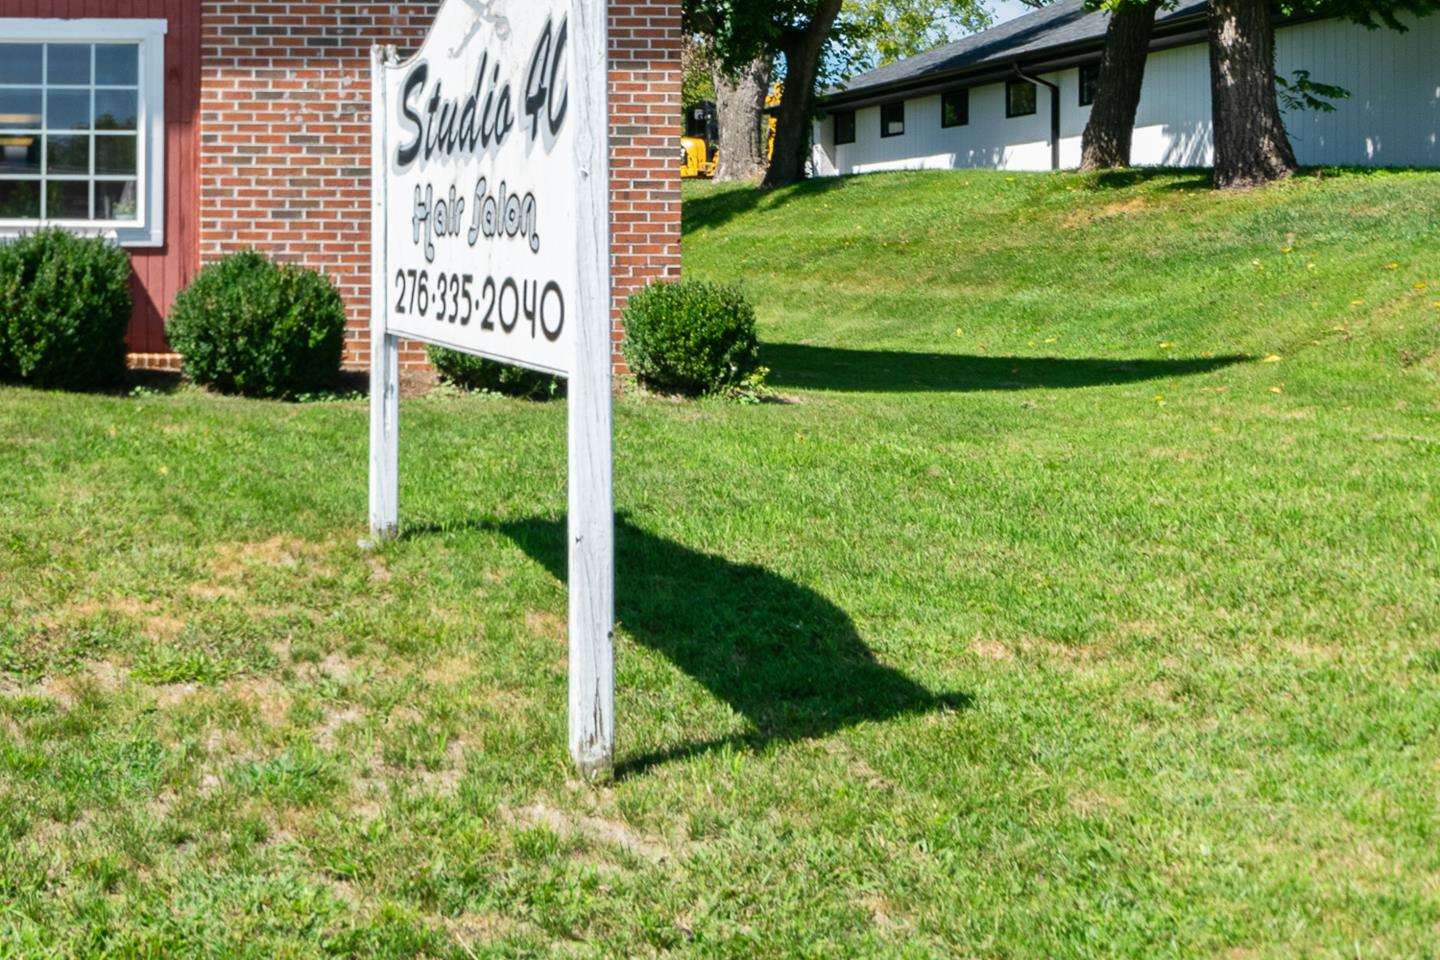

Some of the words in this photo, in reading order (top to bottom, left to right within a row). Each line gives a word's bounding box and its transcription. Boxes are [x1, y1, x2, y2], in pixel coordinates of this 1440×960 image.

[396, 50, 515, 168] Studio
[412, 182, 466, 264] Hair
[467, 175, 540, 255] Salon
